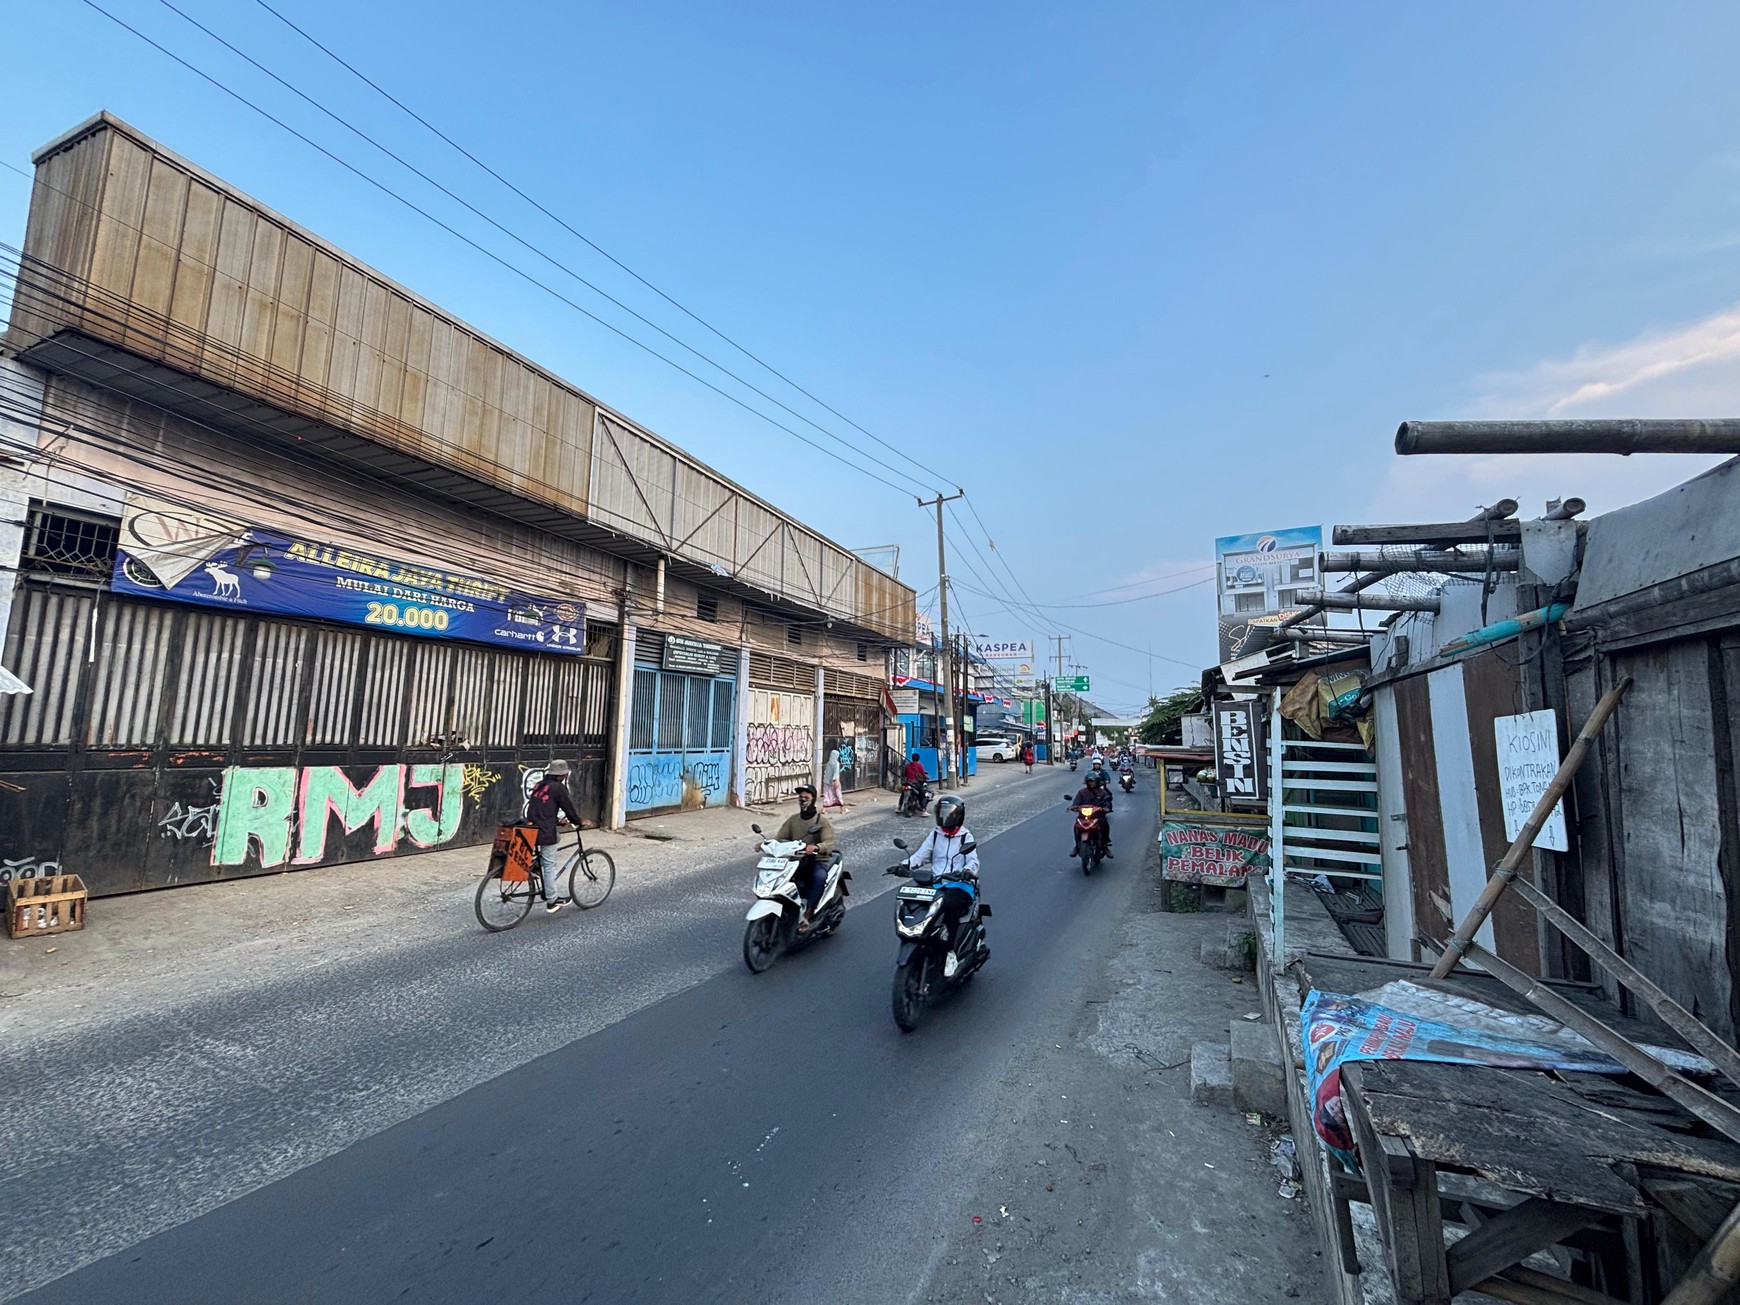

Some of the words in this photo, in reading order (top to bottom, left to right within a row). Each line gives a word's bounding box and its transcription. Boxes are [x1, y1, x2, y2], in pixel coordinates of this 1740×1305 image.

[284, 541, 391, 581] ALLEIRA
[391, 563, 444, 592] JAYA
[446, 574, 511, 604] THRIFT
[336, 576, 389, 597] MULAI
[392, 589, 428, 604] DARI
[430, 594, 475, 613] HARGA
[365, 601, 450, 631] 20.000
[494, 628, 536, 641] carhartt
[975, 642, 1027, 653] KASPEA
[1219, 710, 1255, 793] BENSIN
[1166, 828, 1219, 847] NANAS
[1223, 832, 1271, 855] MADU
[1191, 845, 1244, 863] BELIK
